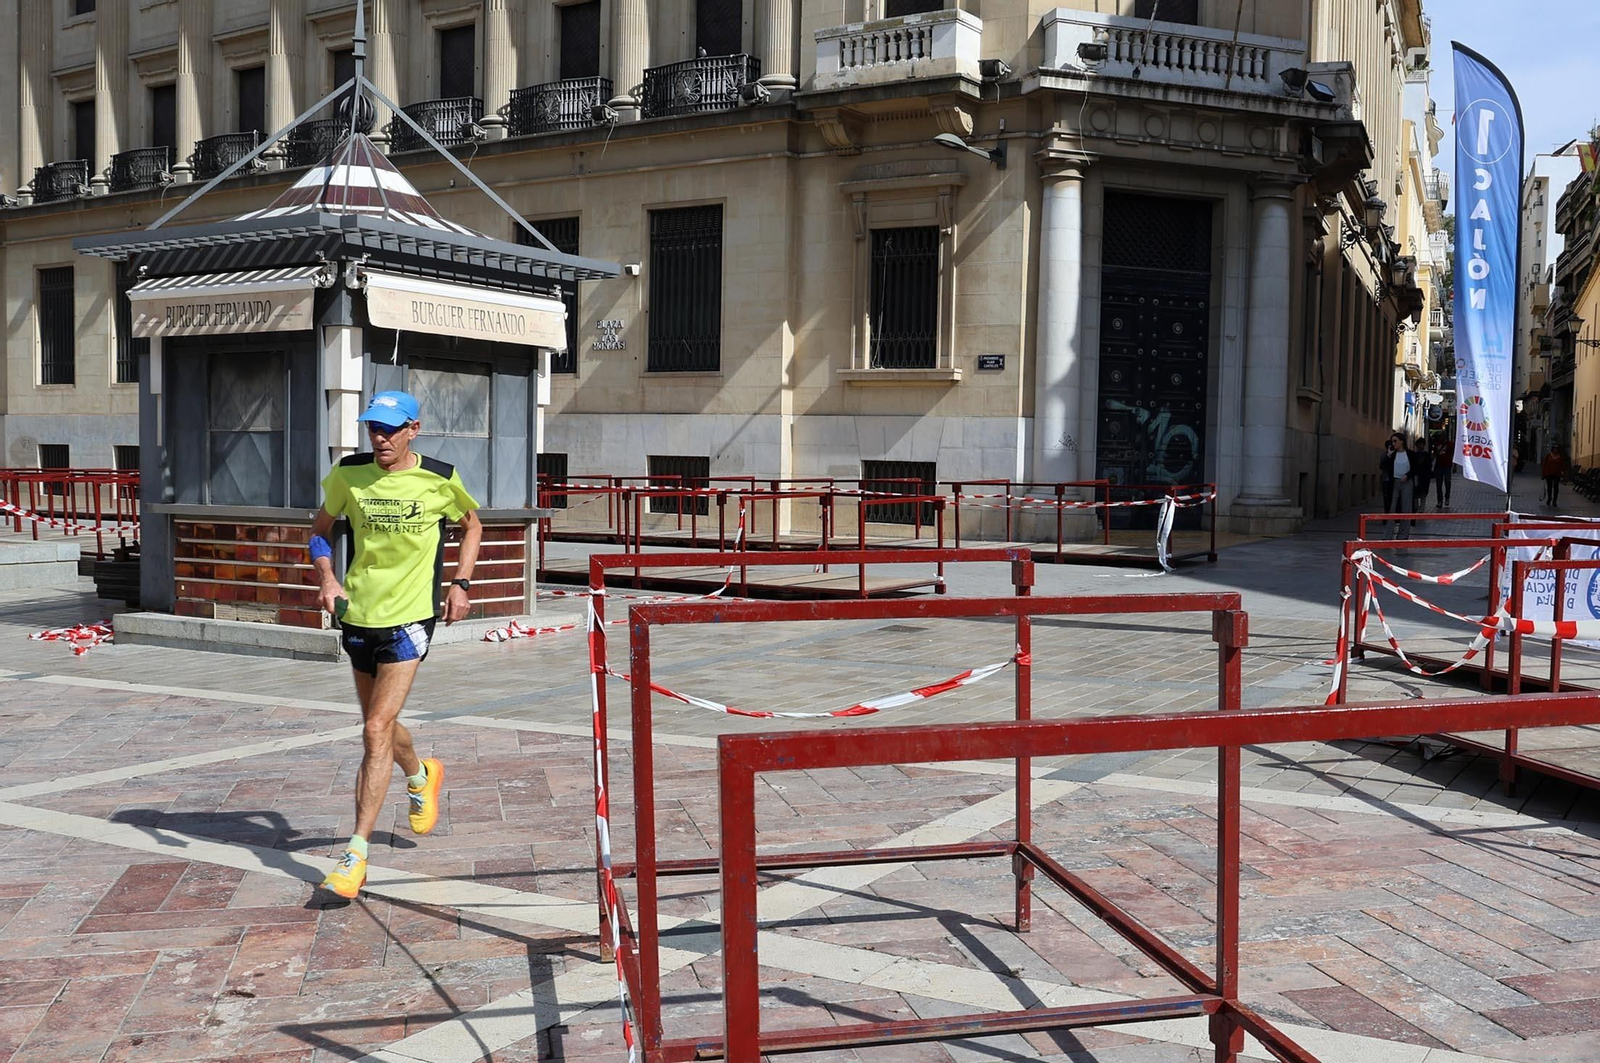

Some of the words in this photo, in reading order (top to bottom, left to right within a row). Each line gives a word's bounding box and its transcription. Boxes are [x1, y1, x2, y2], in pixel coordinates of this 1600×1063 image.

[165, 303, 212, 329] BURGUER
[214, 299, 272, 327] FERNANDO
[411, 300, 466, 328] BURGUER
[467, 306, 526, 336] FERNANDO
[596, 319, 624, 329] PLAZA
[592, 341, 626, 350] MONJAS
[357, 498, 401, 507] Patronato
[360, 506, 400, 515] Municipal
